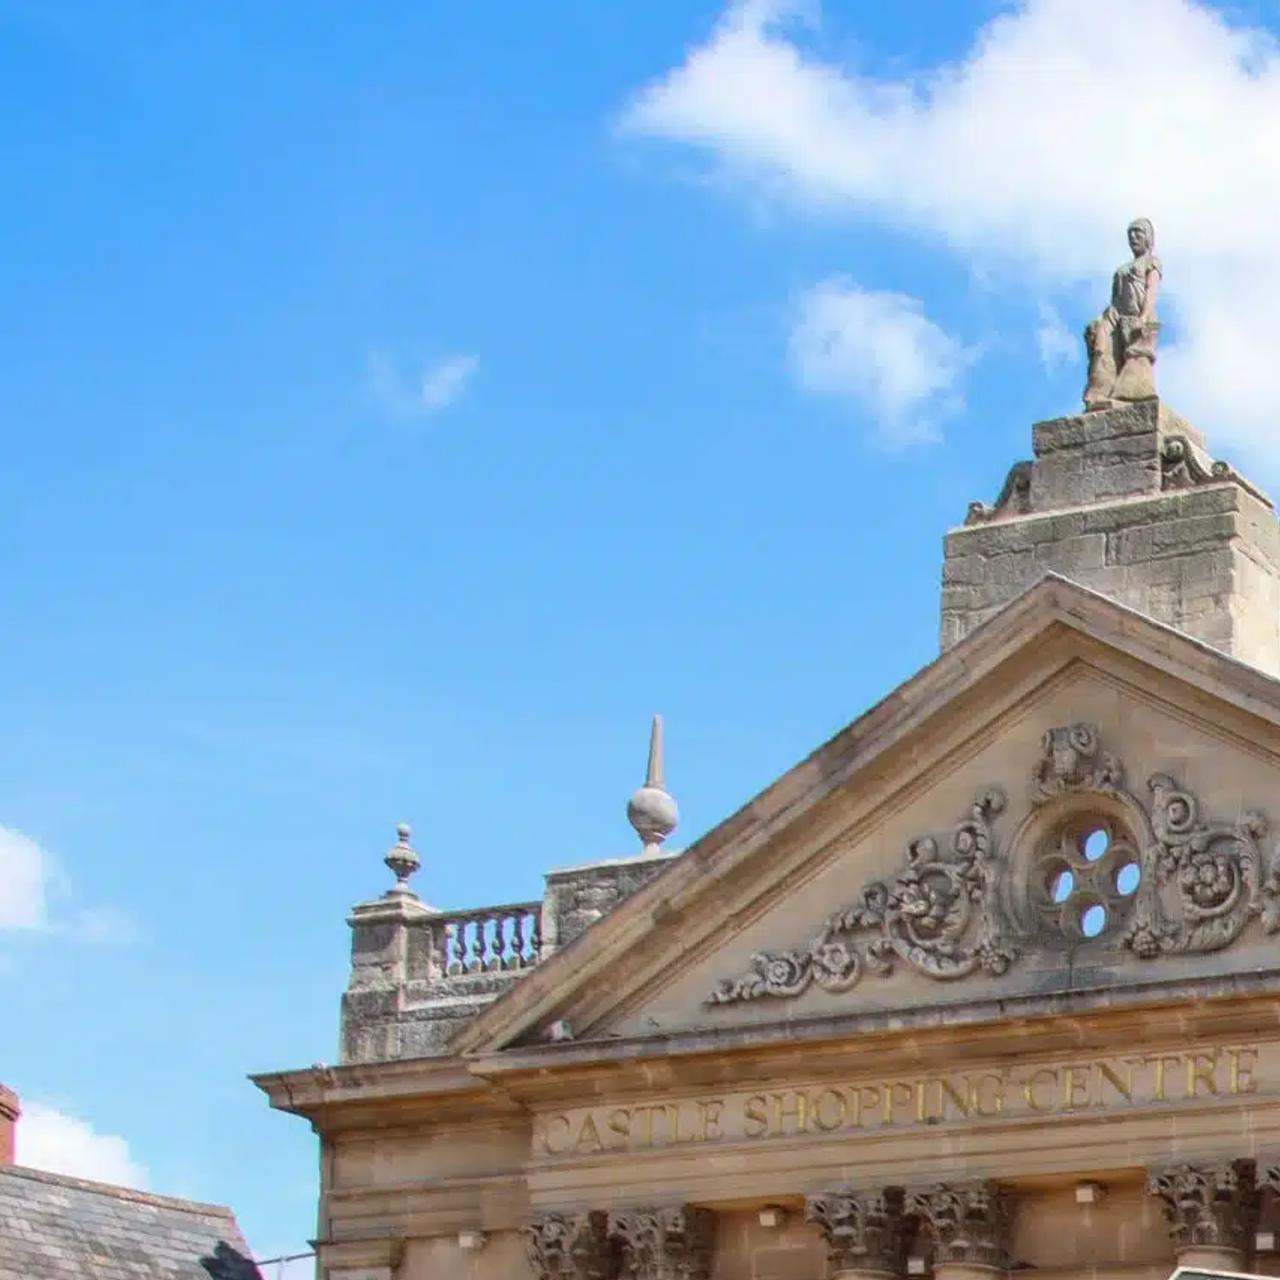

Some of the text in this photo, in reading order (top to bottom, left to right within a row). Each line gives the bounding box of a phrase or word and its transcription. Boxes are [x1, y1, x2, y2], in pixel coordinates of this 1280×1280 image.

[541, 1100, 726, 1156] CASTLE
[743, 1073, 1007, 1136] SHOPPING
[1023, 1046, 1259, 1113] CENTRE
